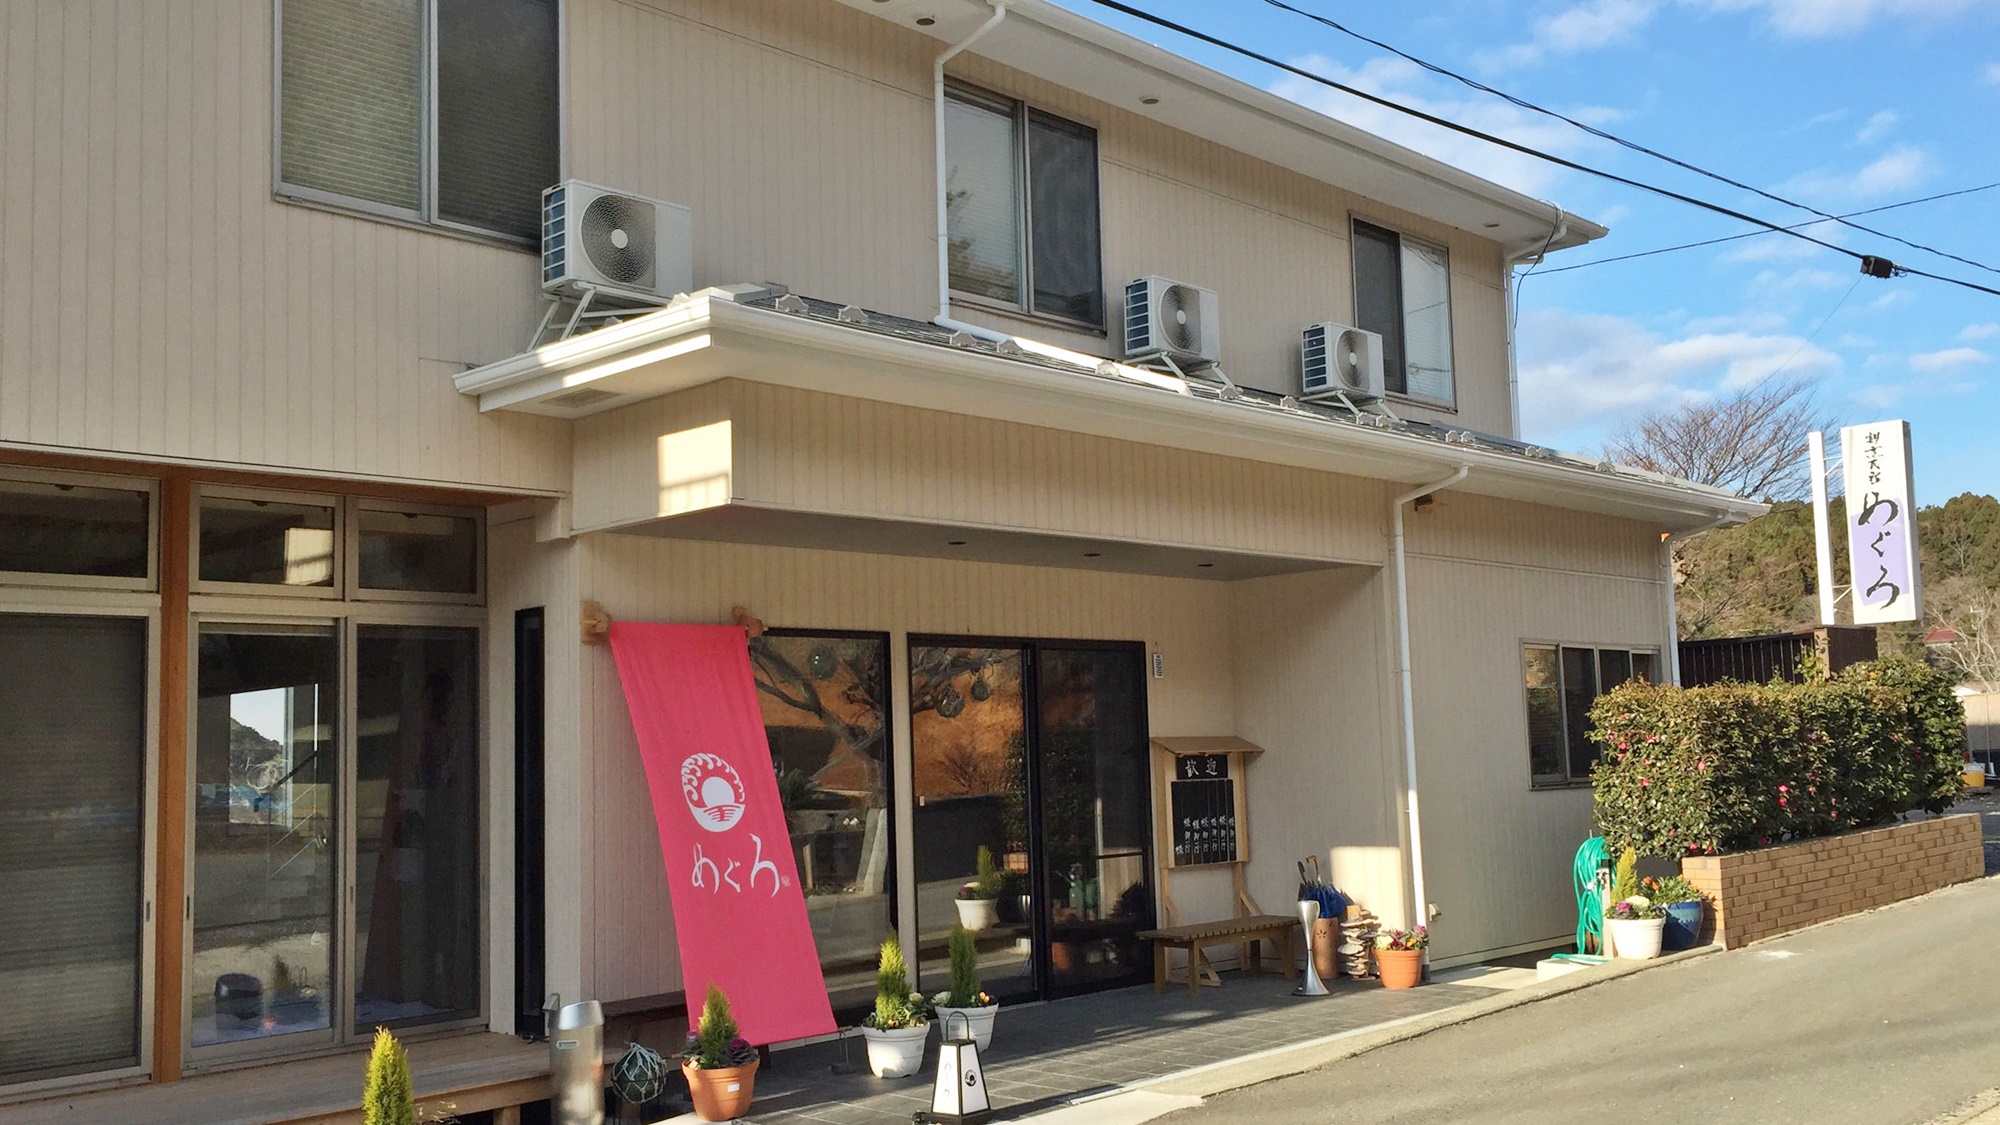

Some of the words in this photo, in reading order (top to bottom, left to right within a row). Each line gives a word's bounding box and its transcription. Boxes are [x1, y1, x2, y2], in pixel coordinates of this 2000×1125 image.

[1858, 491, 1900, 609] めぐろ
[691, 833, 780, 897] めぐろ
